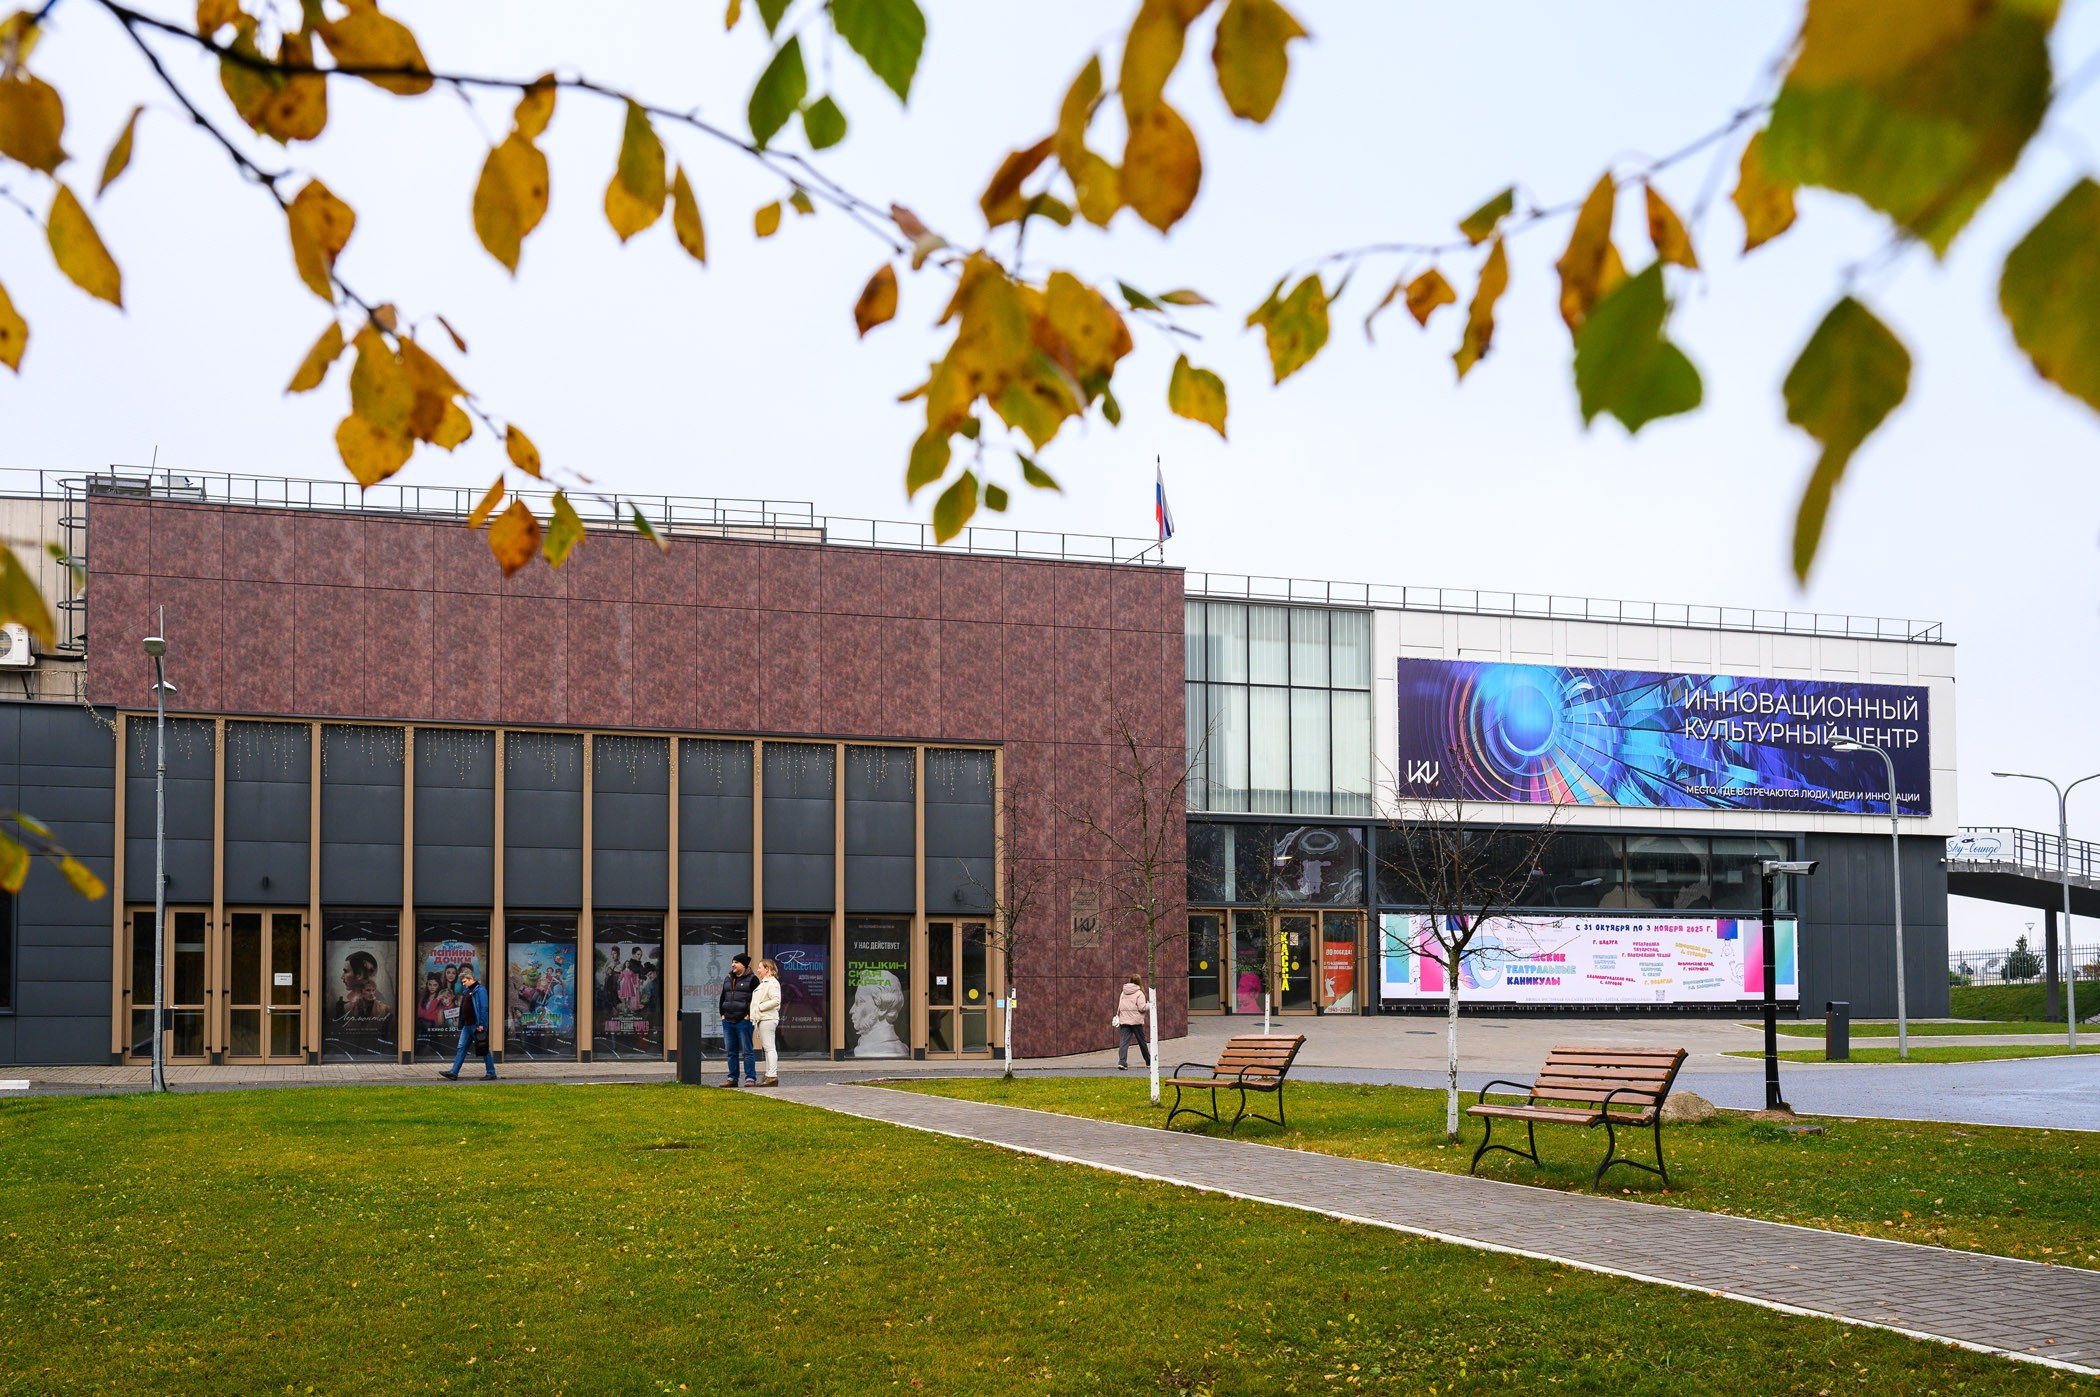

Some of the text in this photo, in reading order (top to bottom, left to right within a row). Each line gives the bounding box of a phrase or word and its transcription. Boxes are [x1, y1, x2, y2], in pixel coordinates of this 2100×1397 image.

[1685, 689, 1919, 721] ИННОВАЦИОННЫЙ
[1685, 719, 1838, 746] КУЛЬТУРНЫЙ
[1686, 785, 1920, 802] МЕСТО, ГДЕ ВСТРЕЧАЮТСЯ ЛЮДИ, ИДЕИ И ИННОАЦИИ
[1596, 924, 1630, 932] ОКТЯБРЯ
[1646, 924, 1651, 932] 3
[1654, 925, 1683, 933] НОЯБРЯ
[1686, 925, 1703, 933] 2025
[853, 940, 900, 950] У НАС ДЕЙСТВУЕТ
[783, 961, 824, 971] COLLECTION
[848, 961, 907, 970] ПУШКИН
[1280, 931, 1290, 991] КАССА
[848, 969, 882, 978] СКАЯ
[1505, 964, 1577, 974] ТЕАТРАЛЬНЫЕ
[848, 978, 892, 987] КАРТА
[1506, 976, 1561, 986] КАНИКУЛЫ
